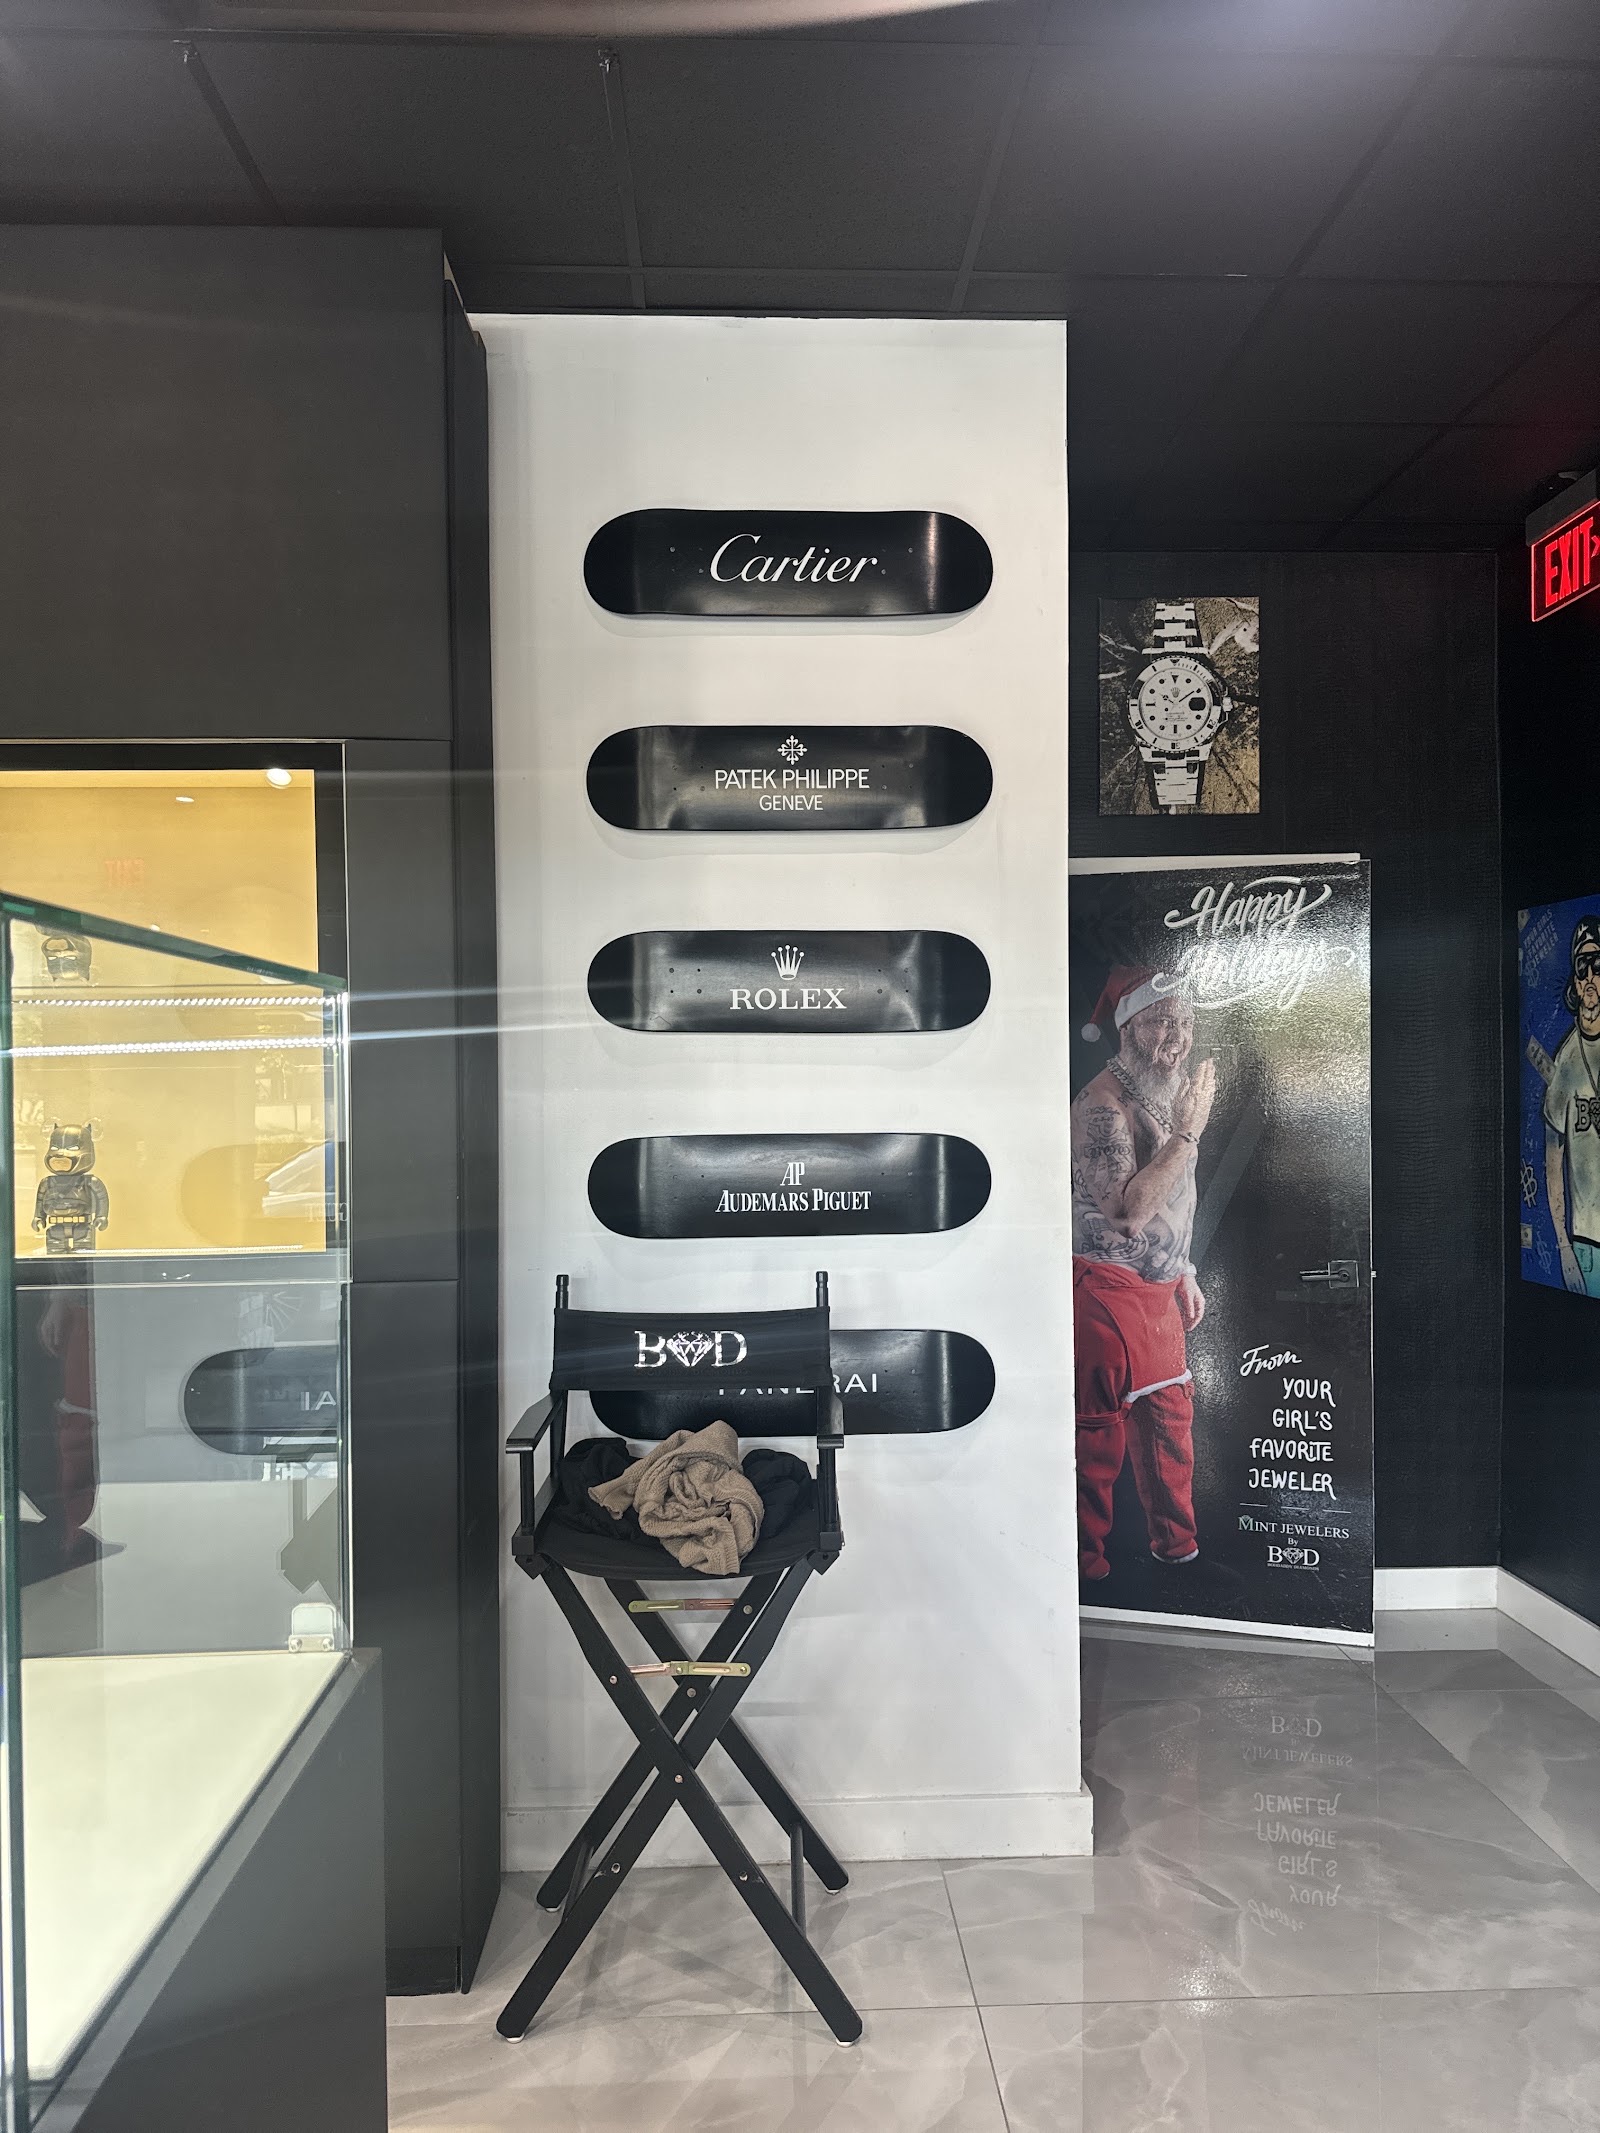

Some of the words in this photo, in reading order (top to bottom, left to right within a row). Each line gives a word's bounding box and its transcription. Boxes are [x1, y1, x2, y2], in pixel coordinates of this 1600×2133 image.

[711, 533, 878, 583] Cartier
[1545, 517, 1594, 608] EXIT
[715, 769, 777, 789] PATEK
[782, 768, 870, 789] PHILIPPE
[759, 795, 824, 811] GENEVE
[1164, 875, 1332, 937] Happy
[729, 988, 848, 1010] ROLEX
[780, 1161, 805, 1186] AP
[715, 1189, 809, 1213] AUDEMARS
[811, 1188, 872, 1211] PIGUET
[1239, 1344, 1303, 1377] From
[1282, 1377, 1337, 1407] YOUR
[1272, 1408, 1334, 1437] GIRL'S
[1249, 1437, 1334, 1462] FAVORITE
[1248, 1468, 1337, 1500] JEWELER
[1238, 1514, 1278, 1534] MINT
[1280, 1522, 1350, 1539] JEWELERS
